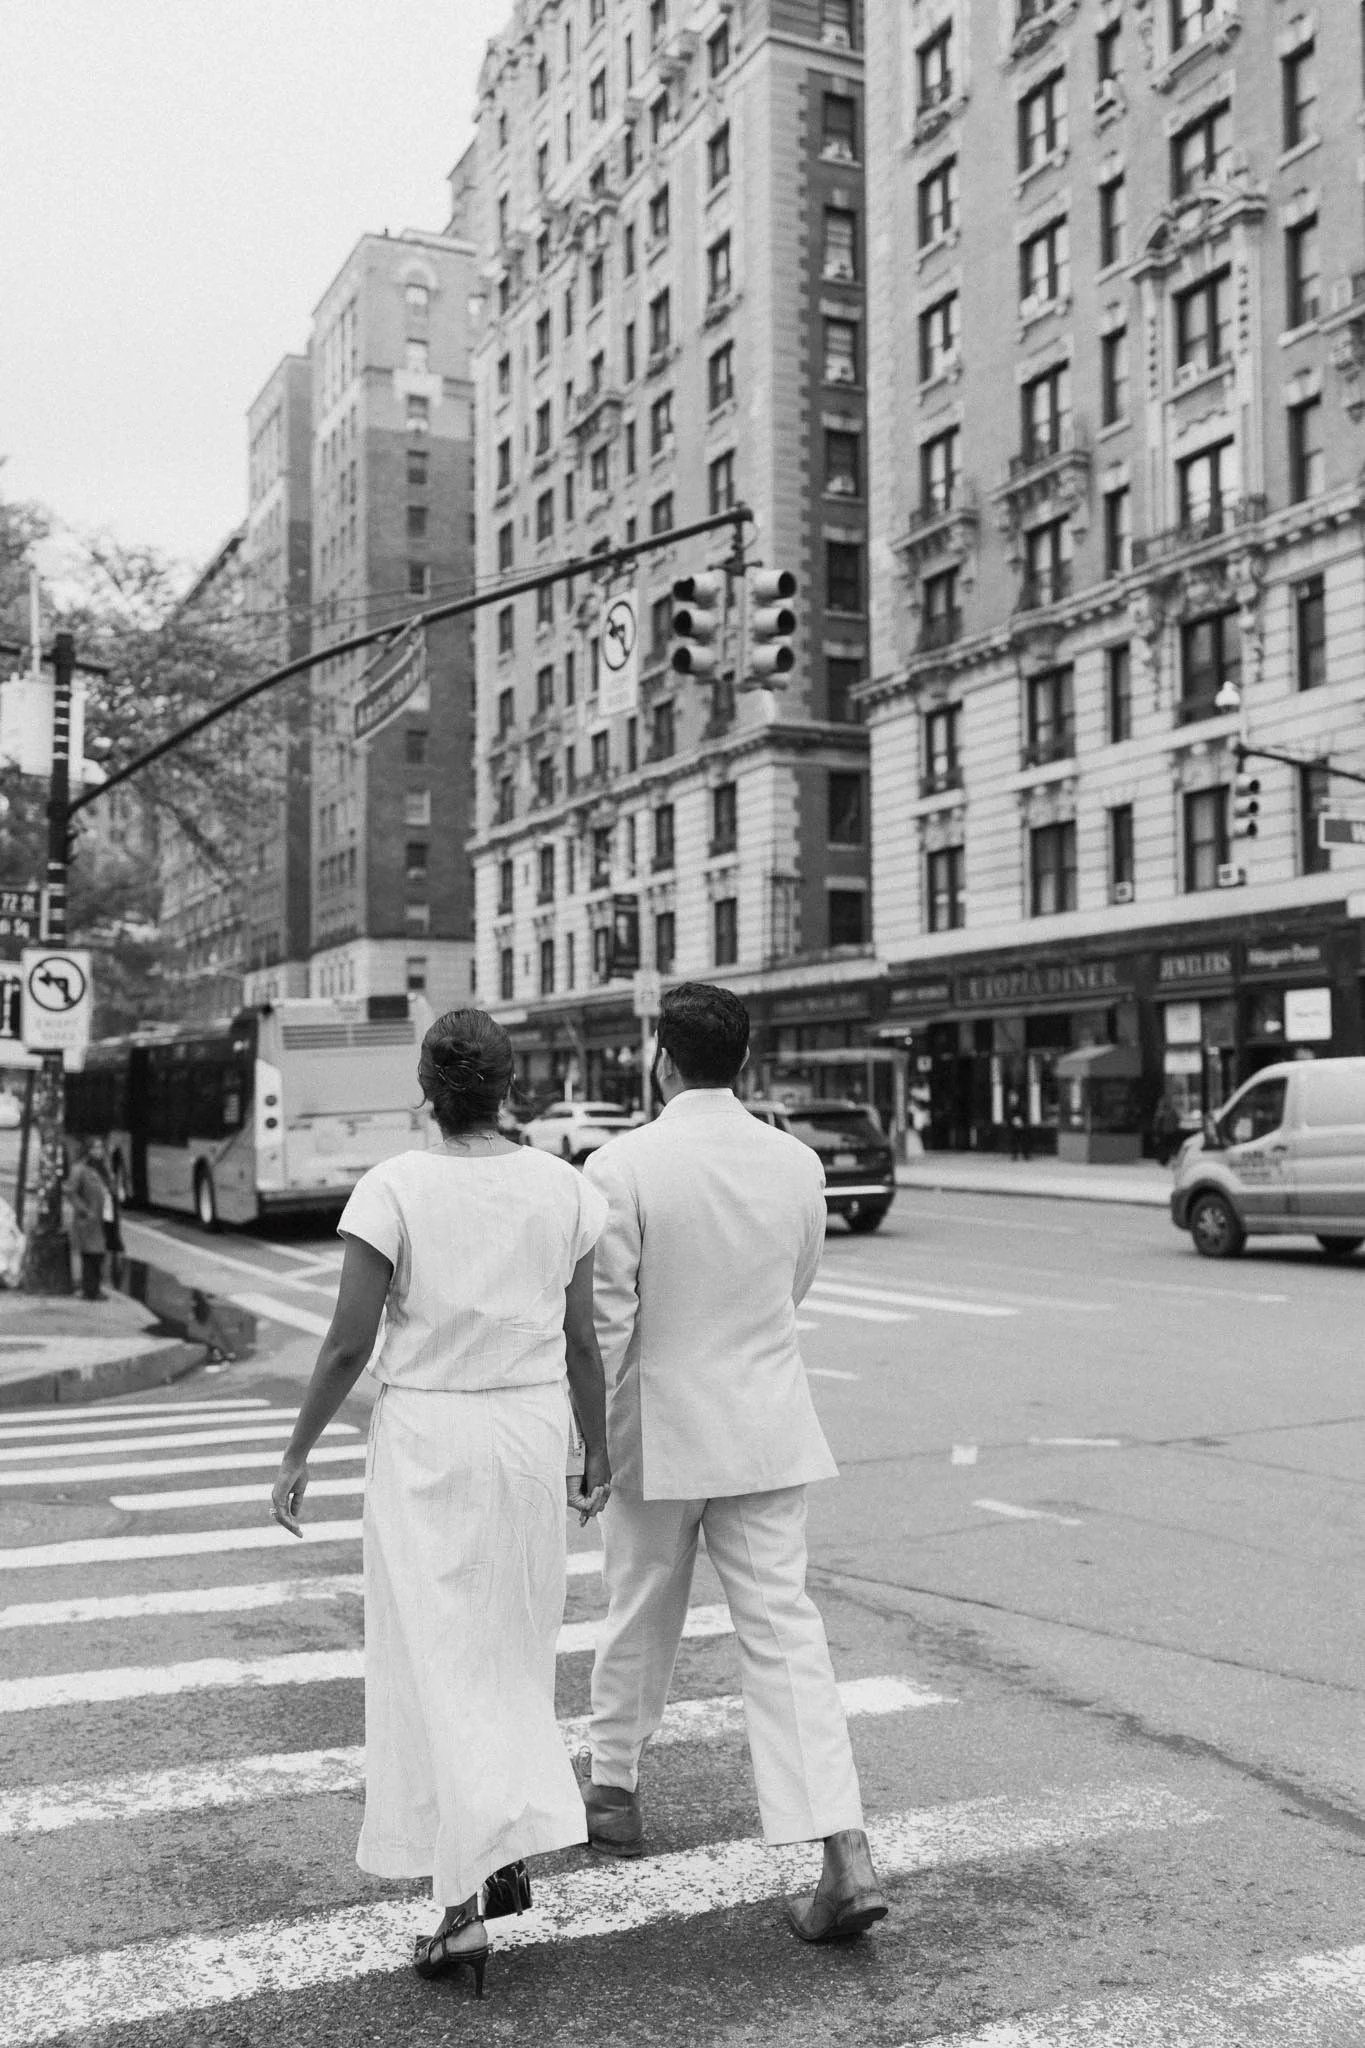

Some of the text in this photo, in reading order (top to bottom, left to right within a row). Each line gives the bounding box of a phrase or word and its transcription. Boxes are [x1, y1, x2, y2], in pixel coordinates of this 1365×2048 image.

[969, 972, 1042, 1000] UTOPIA
[1047, 962, 1117, 992] DINER
[1160, 951, 1231, 979] JEWELERS
